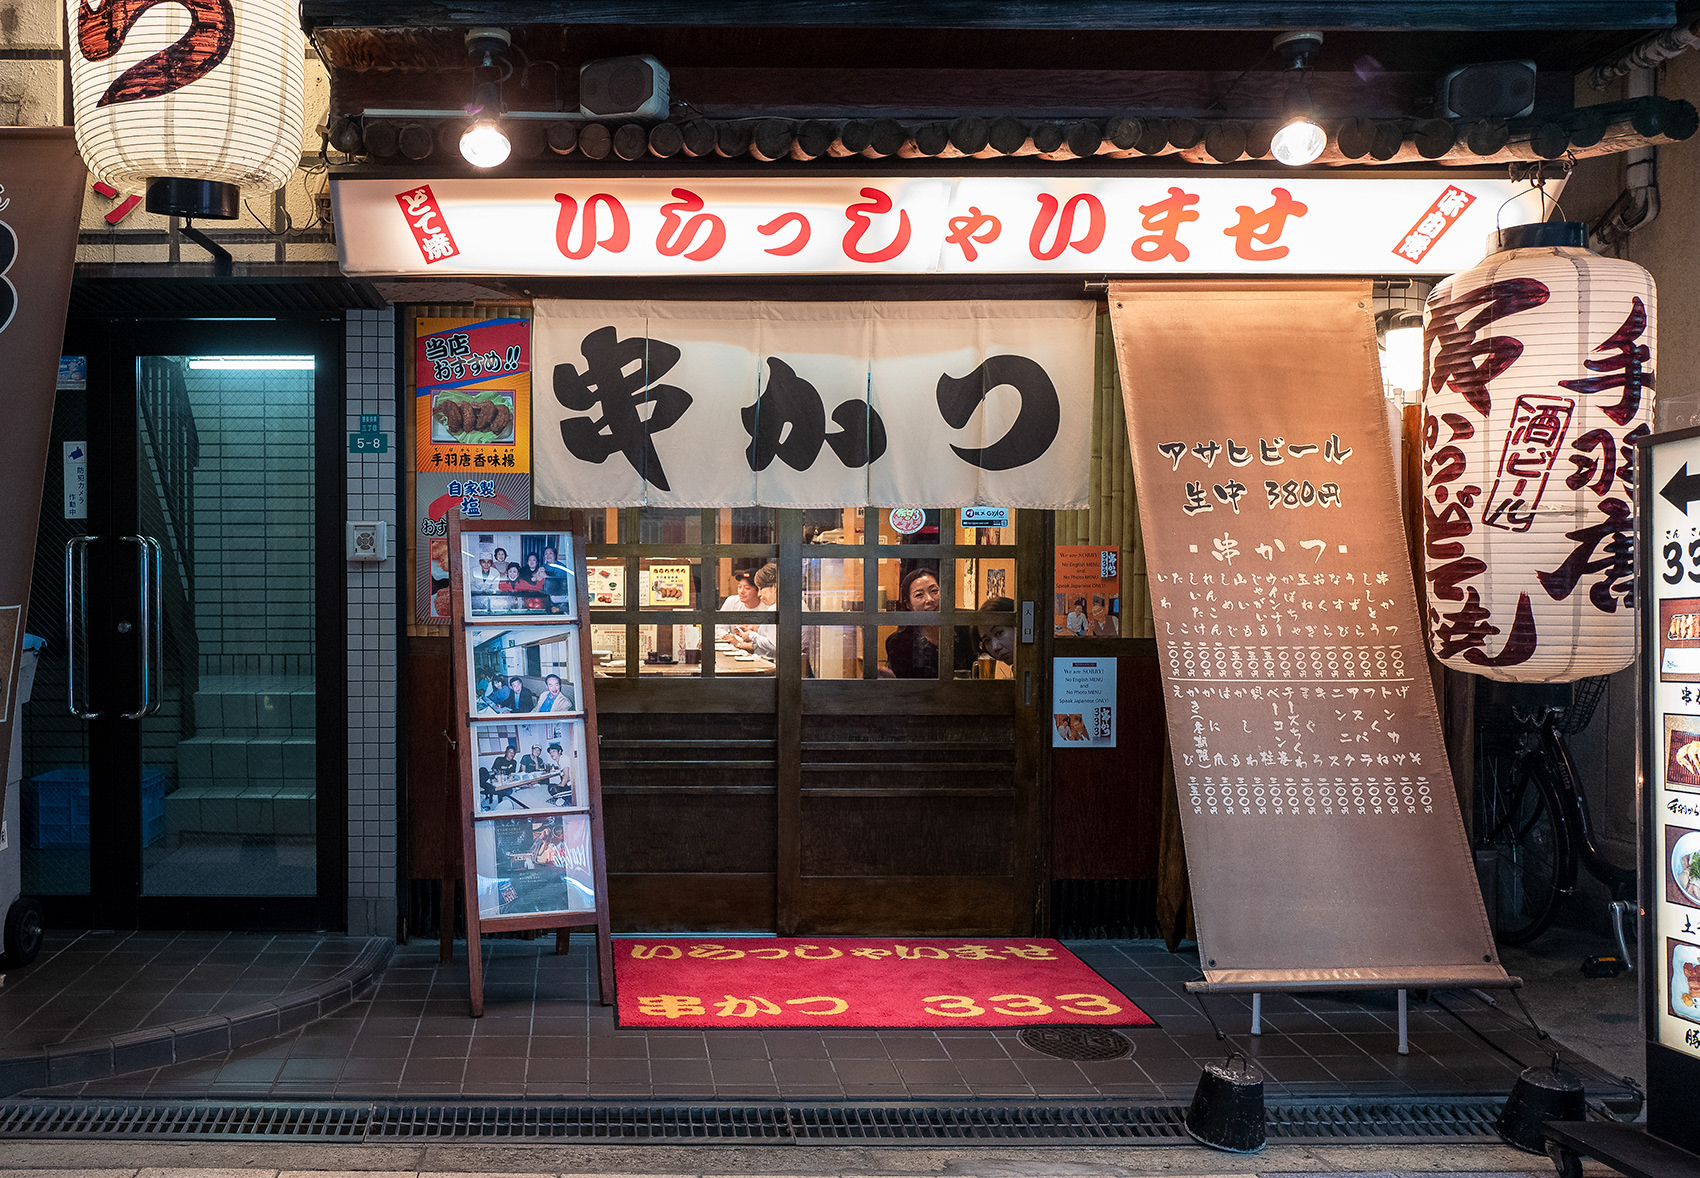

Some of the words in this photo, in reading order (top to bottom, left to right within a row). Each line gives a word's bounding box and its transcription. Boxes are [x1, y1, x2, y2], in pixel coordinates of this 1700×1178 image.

[401, 188, 454, 261] どて焼
[554, 187, 1308, 263] いらっしゃいませ
[425, 333, 471, 361] 当店
[434, 345, 522, 381] おすすめ!!
[552, 325, 1061, 491] 串かつ
[357, 438, 380, 449] 5-8
[431, 453, 515, 467] 手羽唐香味揚
[1157, 433, 1353, 471] アサヒビール
[69, 493, 77, 516] 作動中
[76, 466, 85, 505] 防犯カメラ
[447, 480, 496, 498] 自家製
[461, 496, 481, 516] 塩
[1182, 479, 1248, 516] 生中
[1264, 479, 1342, 510] 380円
[1189, 572, 1206, 636] しいたけ
[1203, 572, 1222, 636] れんこん
[1220, 572, 1239, 638] しめじ
[1250, 573, 1268, 637] じゃがいも
[1281, 574, 1301, 636] かぼちゃ
[1297, 573, 1318, 638] 玉ねぎ
[1313, 573, 1333, 638] おくら
[1328, 573, 1349, 638] なすび
[1345, 572, 1365, 638] うずら
[1362, 572, 1379, 636] ししとう
[1376, 571, 1398, 637] 串かつ
[631, 943, 1059, 961] いらっしゃいませ
[637, 994, 849, 1019] 串かつ
[923, 993, 1122, 1018] 333
